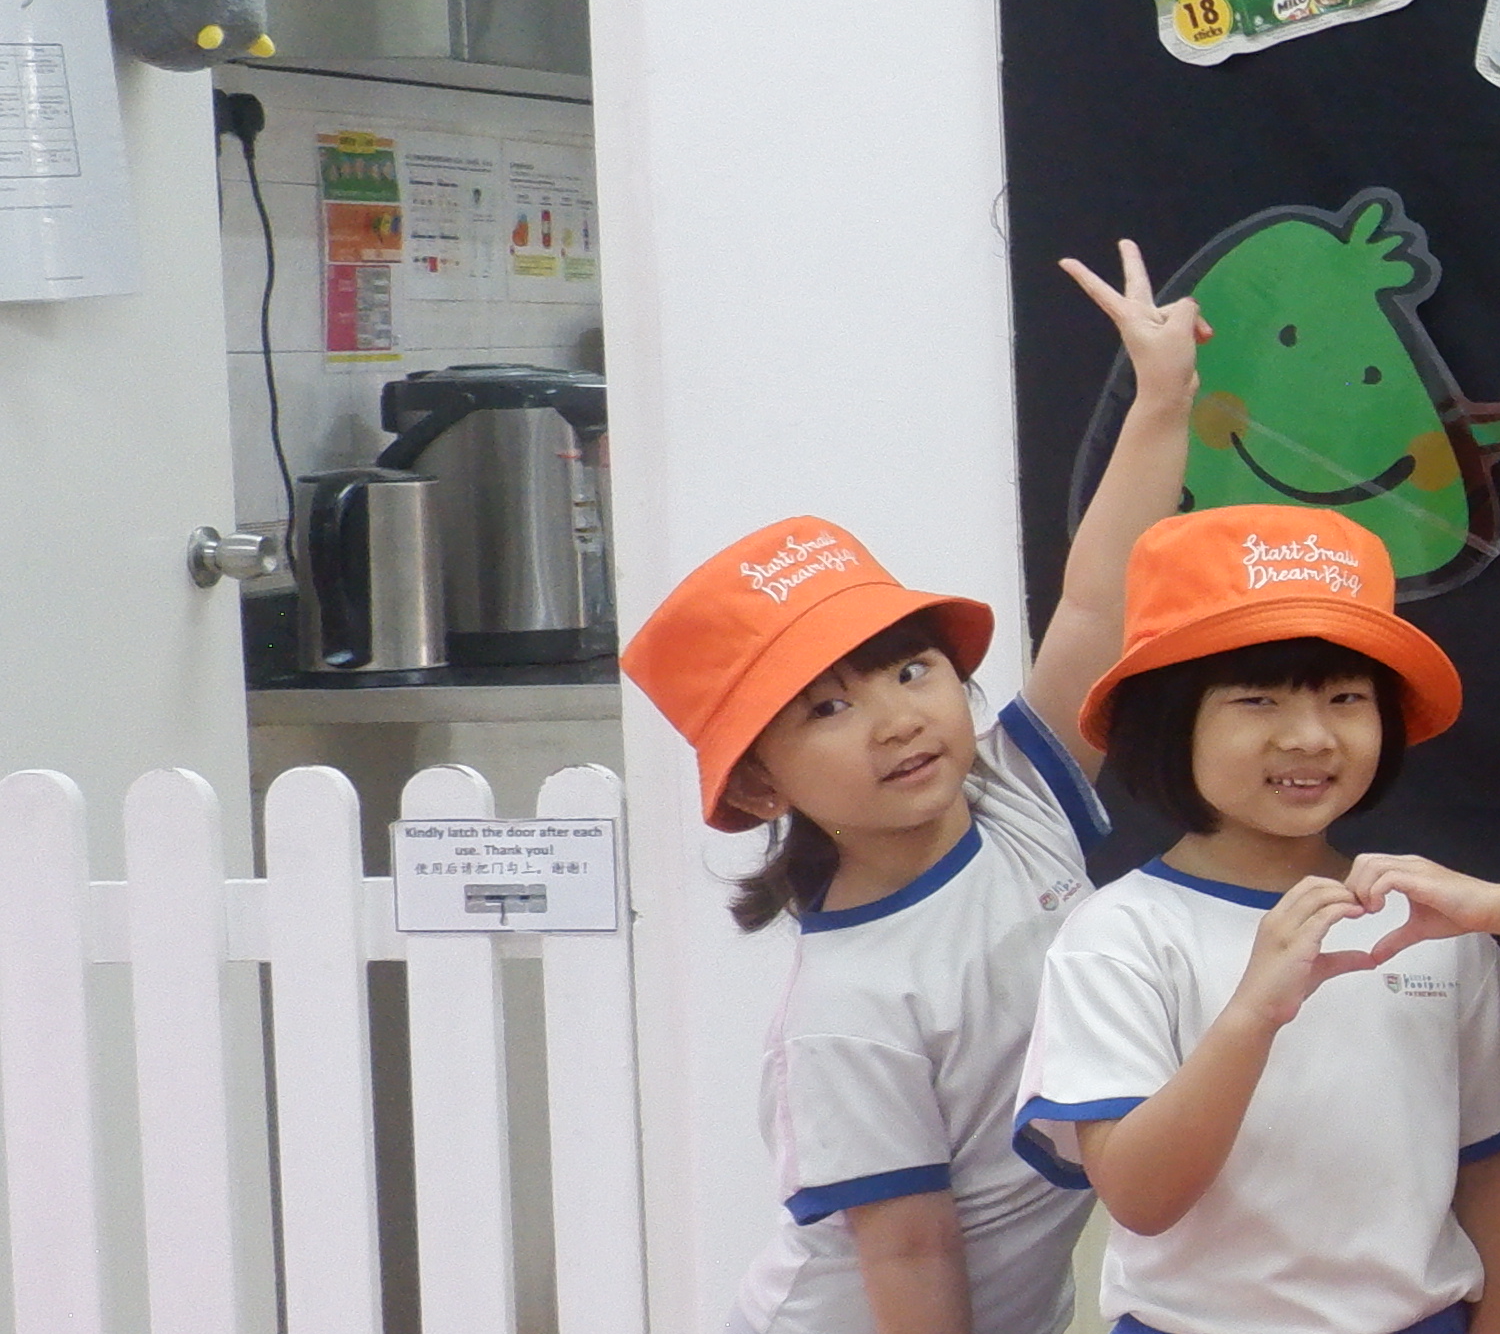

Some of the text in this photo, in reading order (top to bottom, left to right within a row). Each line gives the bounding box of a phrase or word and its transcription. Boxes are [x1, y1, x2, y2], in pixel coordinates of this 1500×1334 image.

[1193, 24, 1225, 43] sticks
[741, 534, 836, 587] Start Small
[1243, 534, 1358, 567] Start Small
[763, 546, 859, 603] Dream Big
[1246, 565, 1362, 596] Dream Big
[405, 826, 603, 840] Kindly latch the door after each
[455, 844, 554, 859] use. Thank you!
